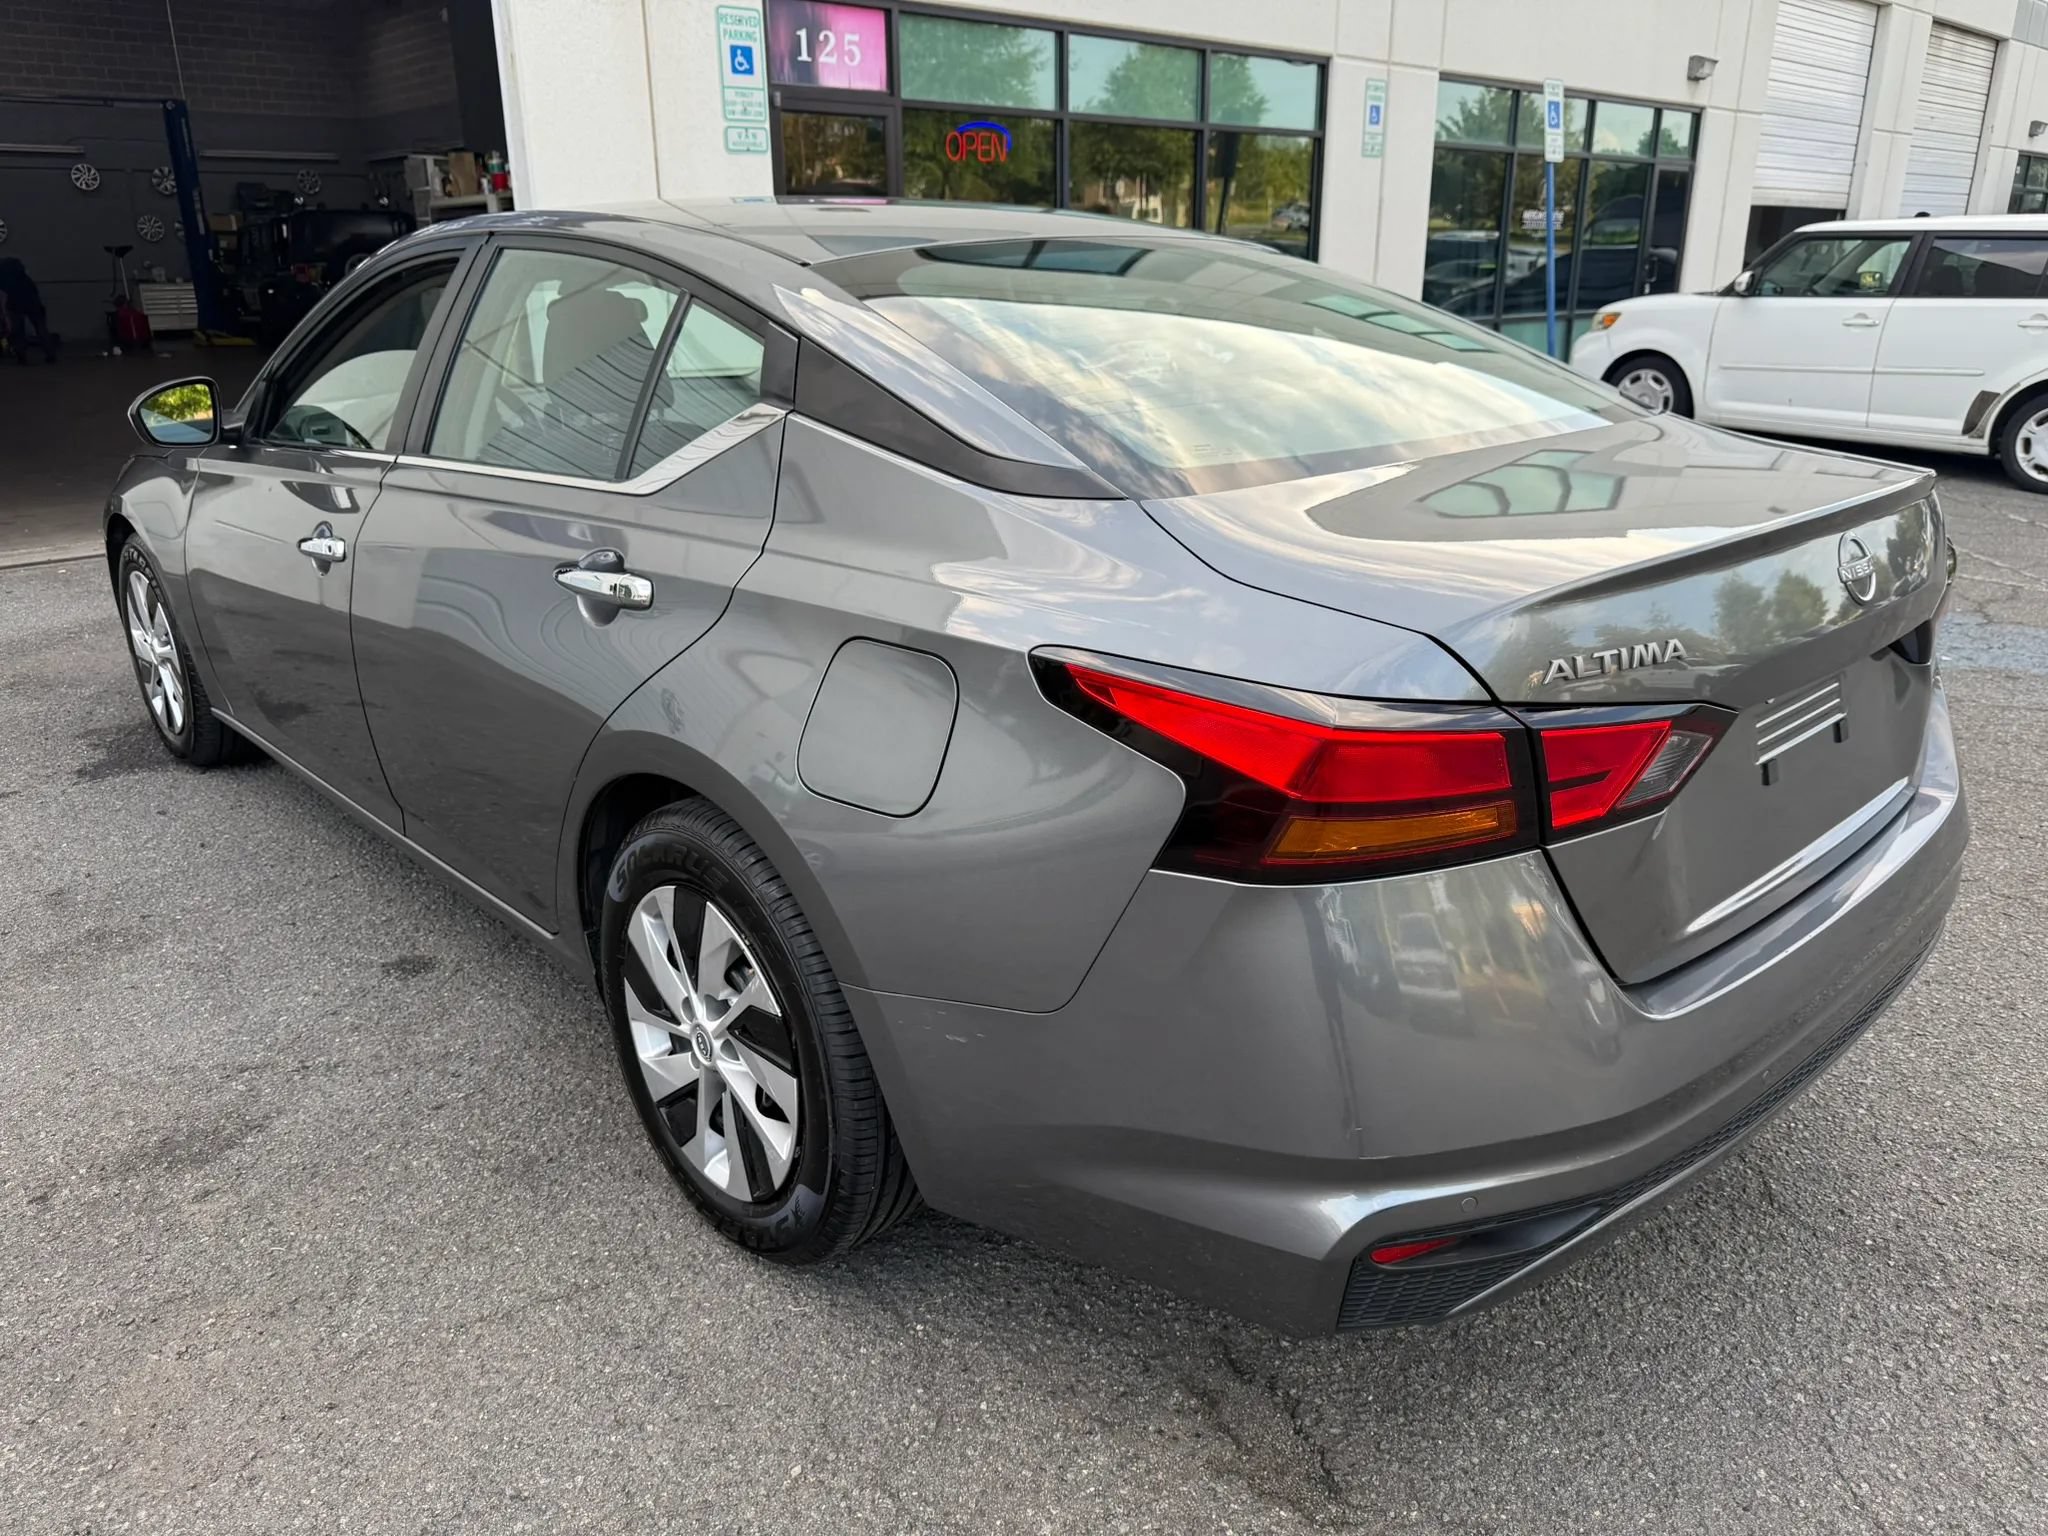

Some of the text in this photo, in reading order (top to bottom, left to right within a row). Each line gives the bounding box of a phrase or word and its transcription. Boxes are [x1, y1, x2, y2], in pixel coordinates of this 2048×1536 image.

[719, 12, 760, 28] RESERVED
[722, 28, 757, 42] PARKING
[796, 28, 862, 66] 125
[945, 131, 1008, 163] OPEN
[1542, 638, 1690, 685] ALTIMA
